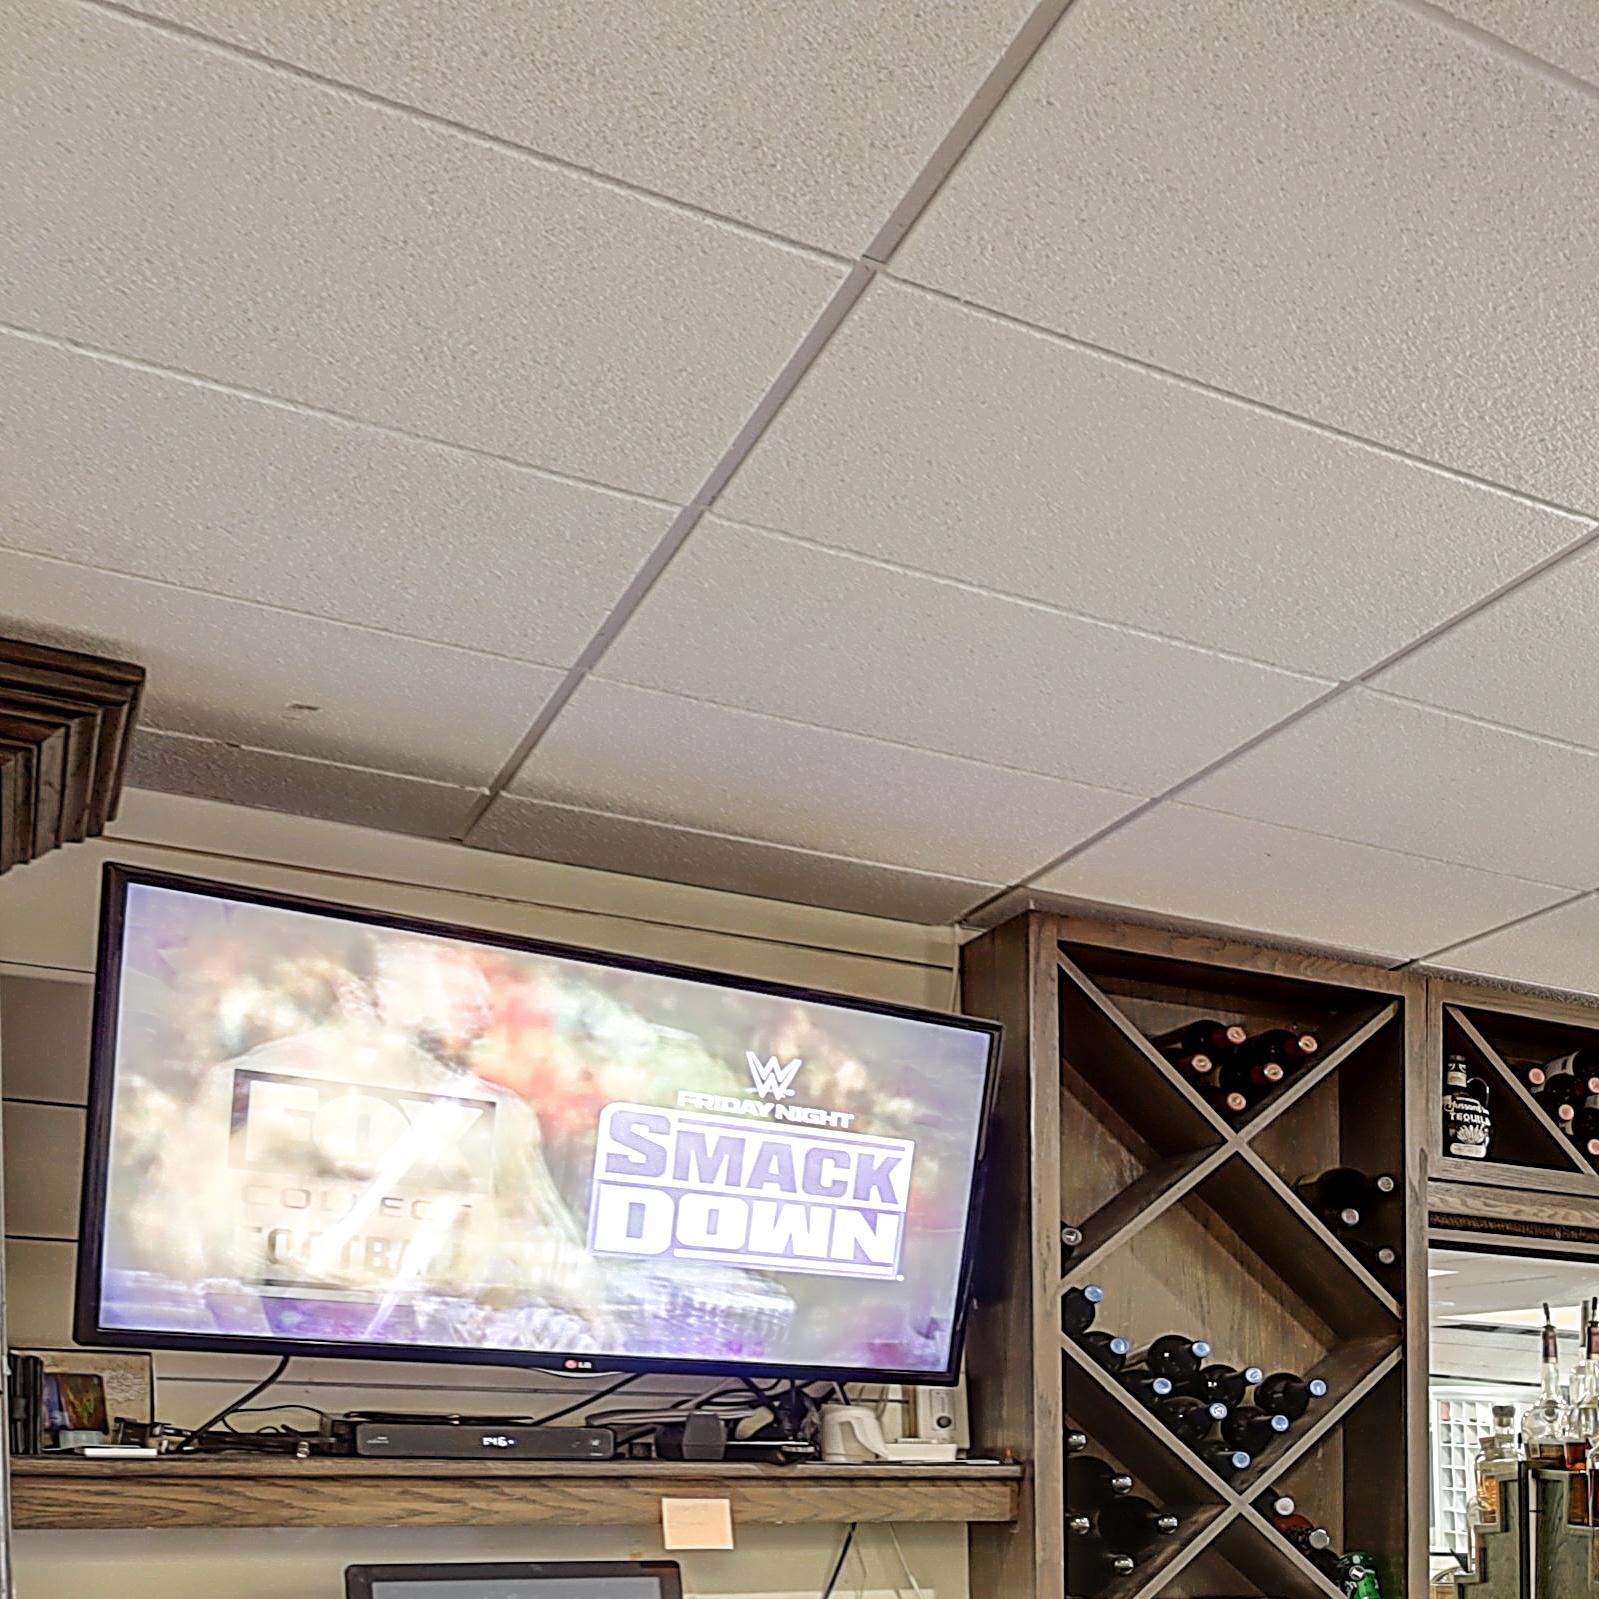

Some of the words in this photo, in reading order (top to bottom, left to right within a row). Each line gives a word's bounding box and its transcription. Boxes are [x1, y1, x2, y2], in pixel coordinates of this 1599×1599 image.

[676, 1089, 776, 1118] FRIDAY
[774, 1103, 855, 1129] NIGHT
[1449, 1112, 1491, 1126] TEQUILA
[605, 1109, 902, 1205] SMACK
[593, 1183, 902, 1264] DOWN
